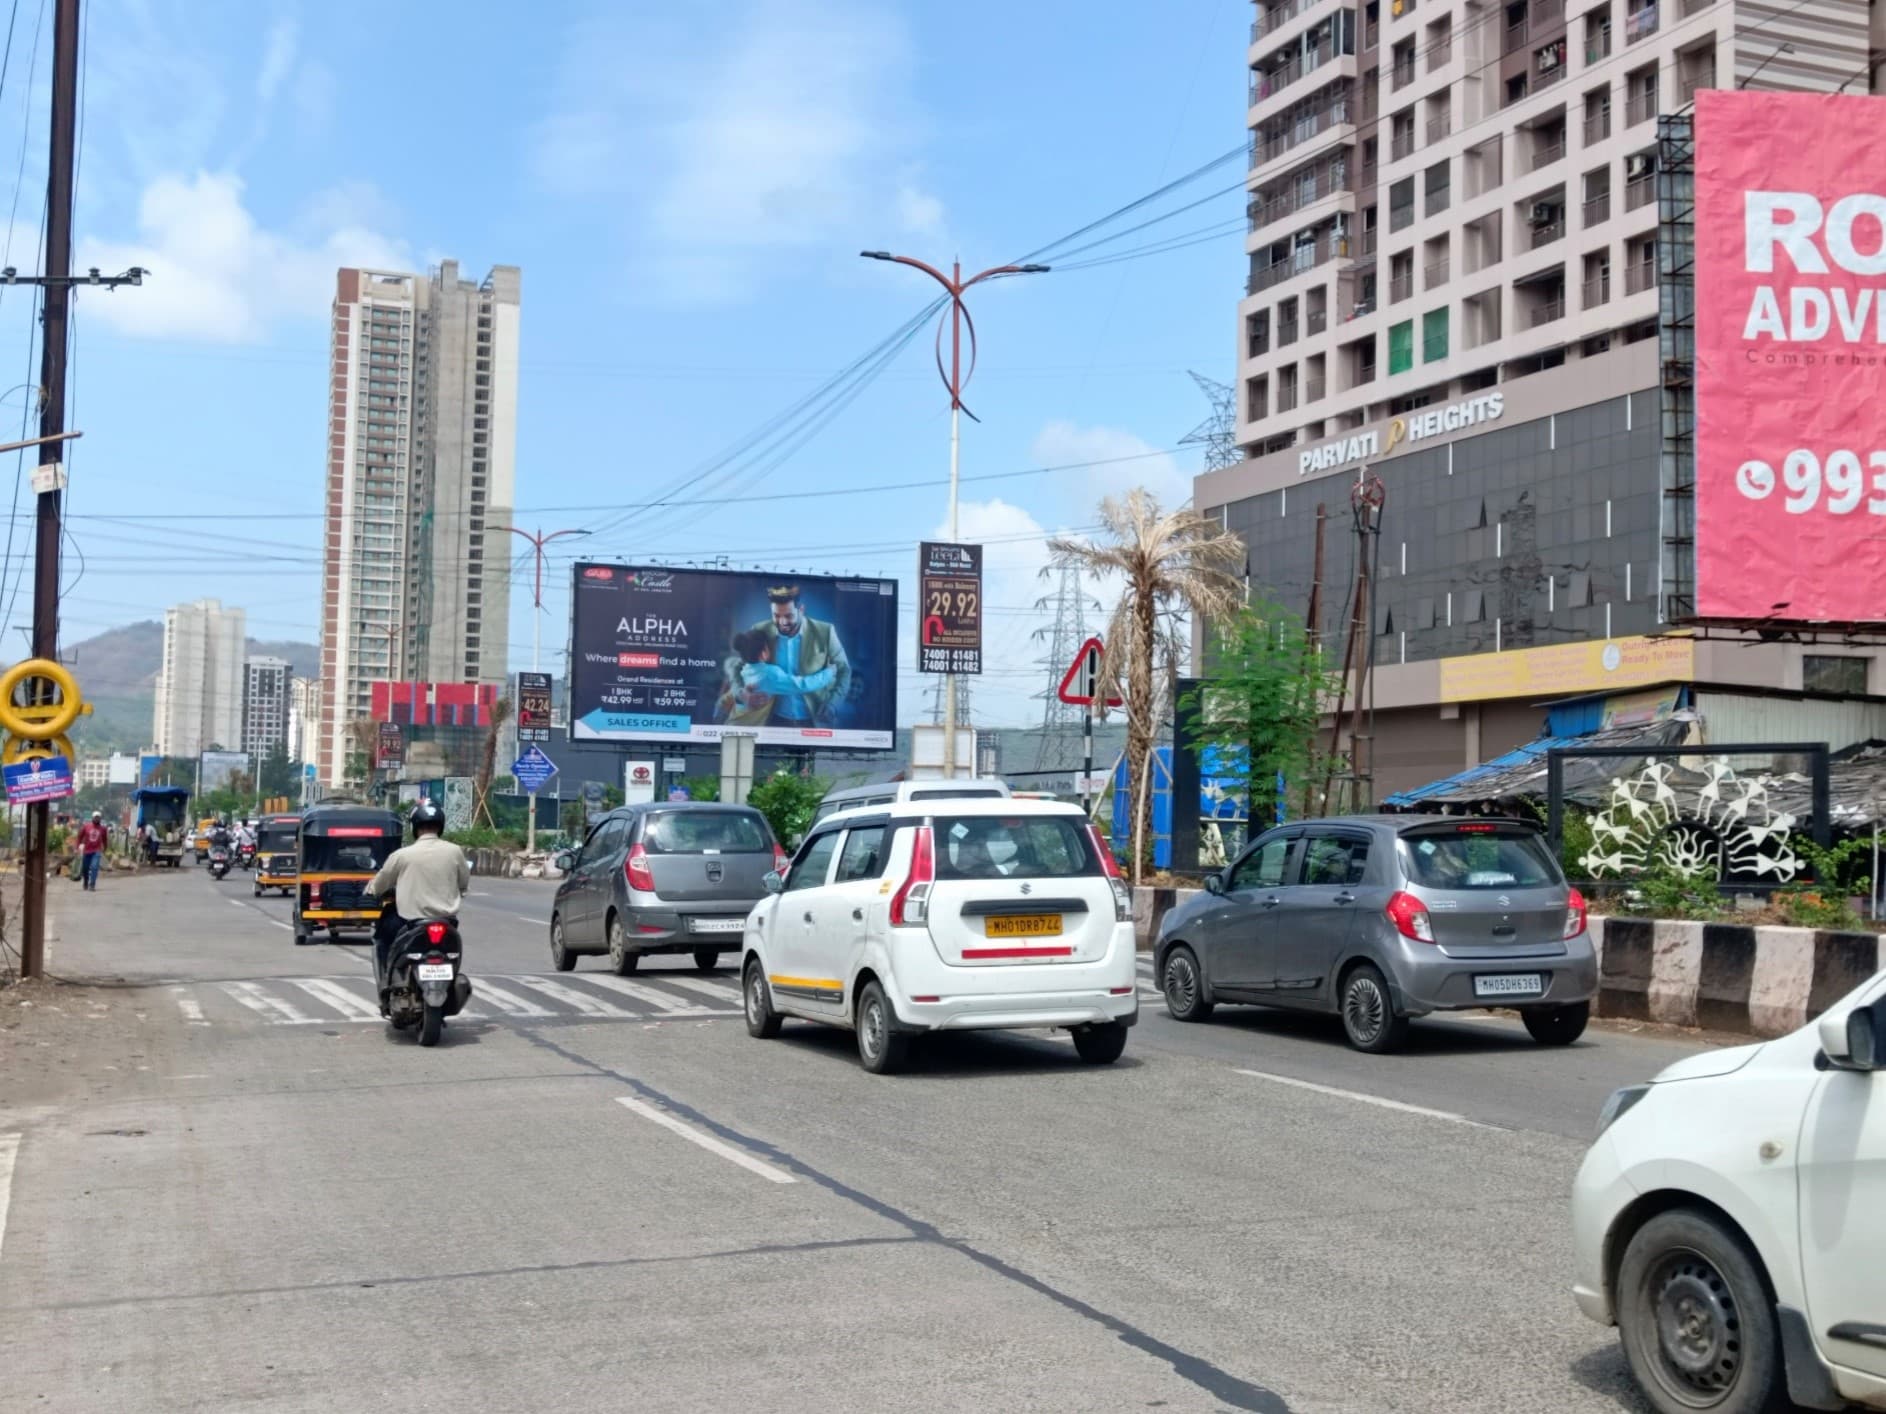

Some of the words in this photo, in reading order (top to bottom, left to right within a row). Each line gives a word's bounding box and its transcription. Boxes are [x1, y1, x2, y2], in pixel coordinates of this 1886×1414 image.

[1300, 430, 1379, 475] PARVATI
[1409, 392, 1504, 442] HEIGHTS
[616, 617, 688, 636] ALPHA
[585, 653, 617, 663] Where
[619, 655, 658, 665] dreams
[659, 657, 678, 666] find
[688, 658, 716, 668] home
[923, 649, 950, 660] 74001
[616, 688, 633, 696] BHK
[670, 690, 687, 698] BHK
[607, 719, 639, 727] SALES
[641, 719, 678, 728] OFFICE
[994, 919, 1060, 933] MH01DR8744
[1483, 977, 1539, 991] MH05DH6369
